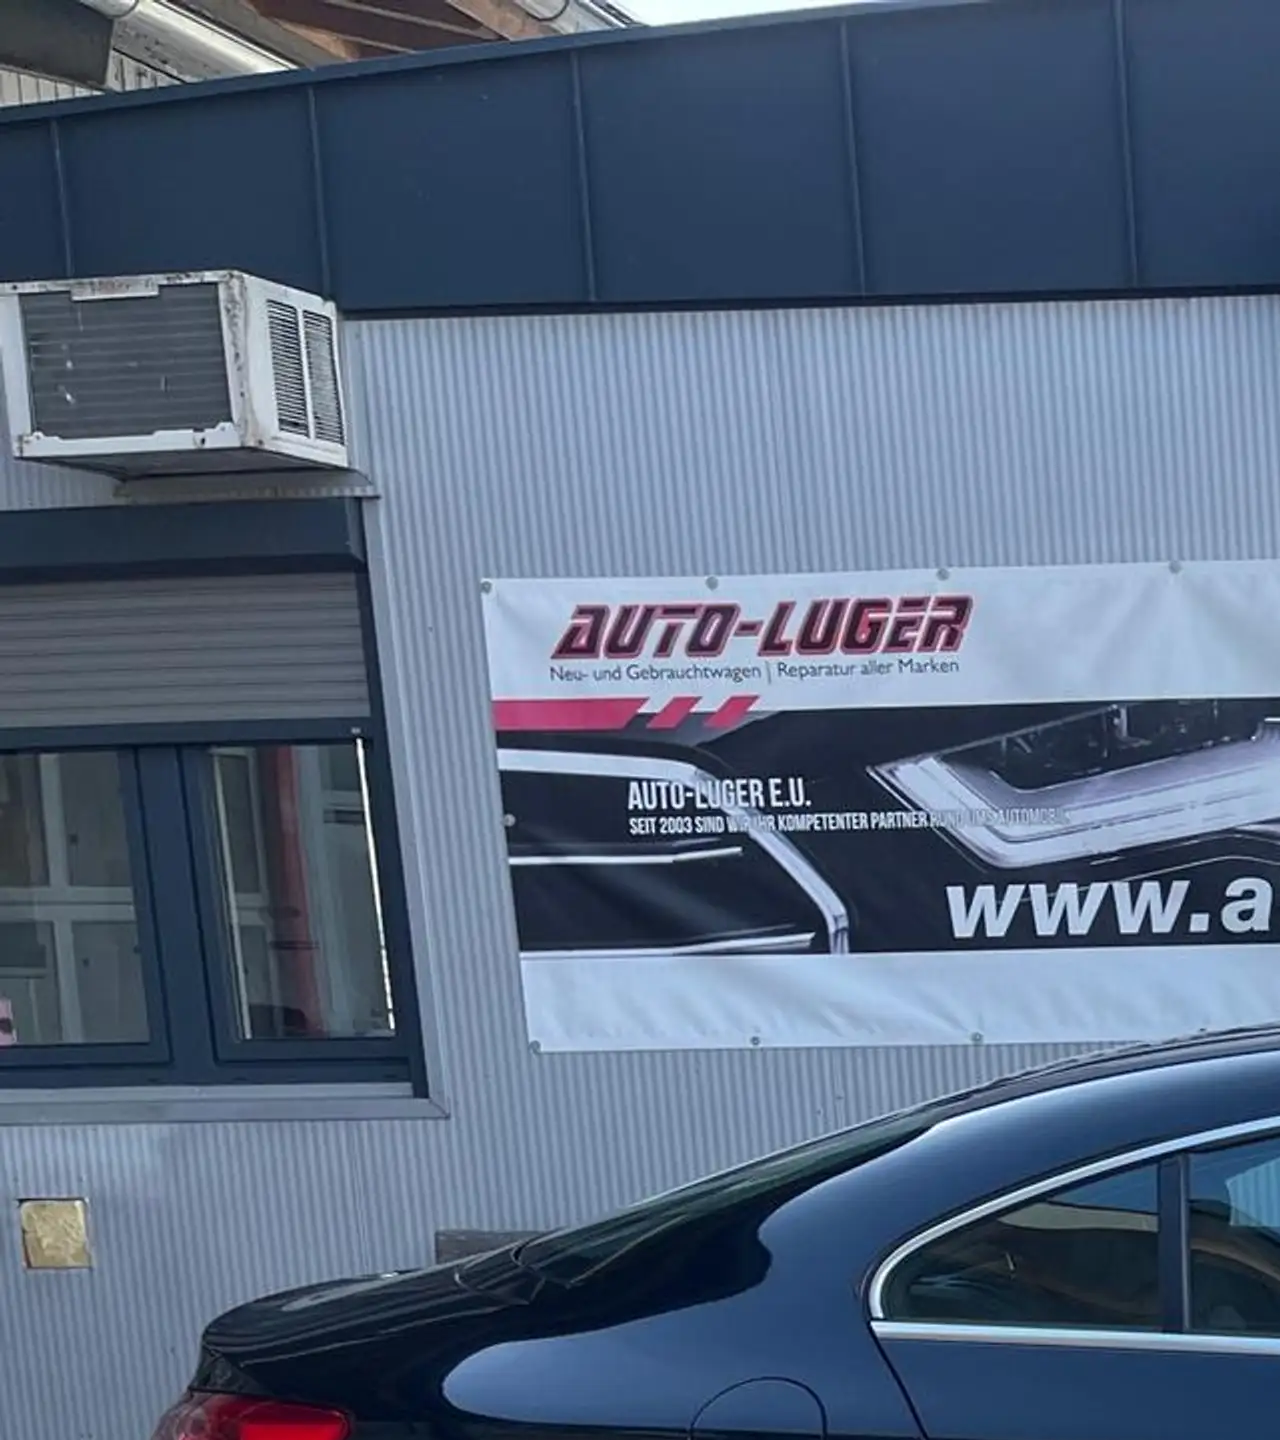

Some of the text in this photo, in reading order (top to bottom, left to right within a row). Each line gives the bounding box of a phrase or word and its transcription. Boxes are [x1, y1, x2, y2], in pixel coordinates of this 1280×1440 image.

[550, 594, 974, 660] AUTO-LUGER
[550, 657, 960, 684] Neu- und Gebrauchtwagen Reparatur aller Marken
[627, 777, 812, 810] AUTO-LUGER E.U.
[628, 816, 657, 835] SEIT
[659, 816, 692, 834] 2003
[694, 815, 725, 834] SIND
[777, 811, 869, 832] KOMPETENTER
[871, 810, 928, 830] PARTNER
